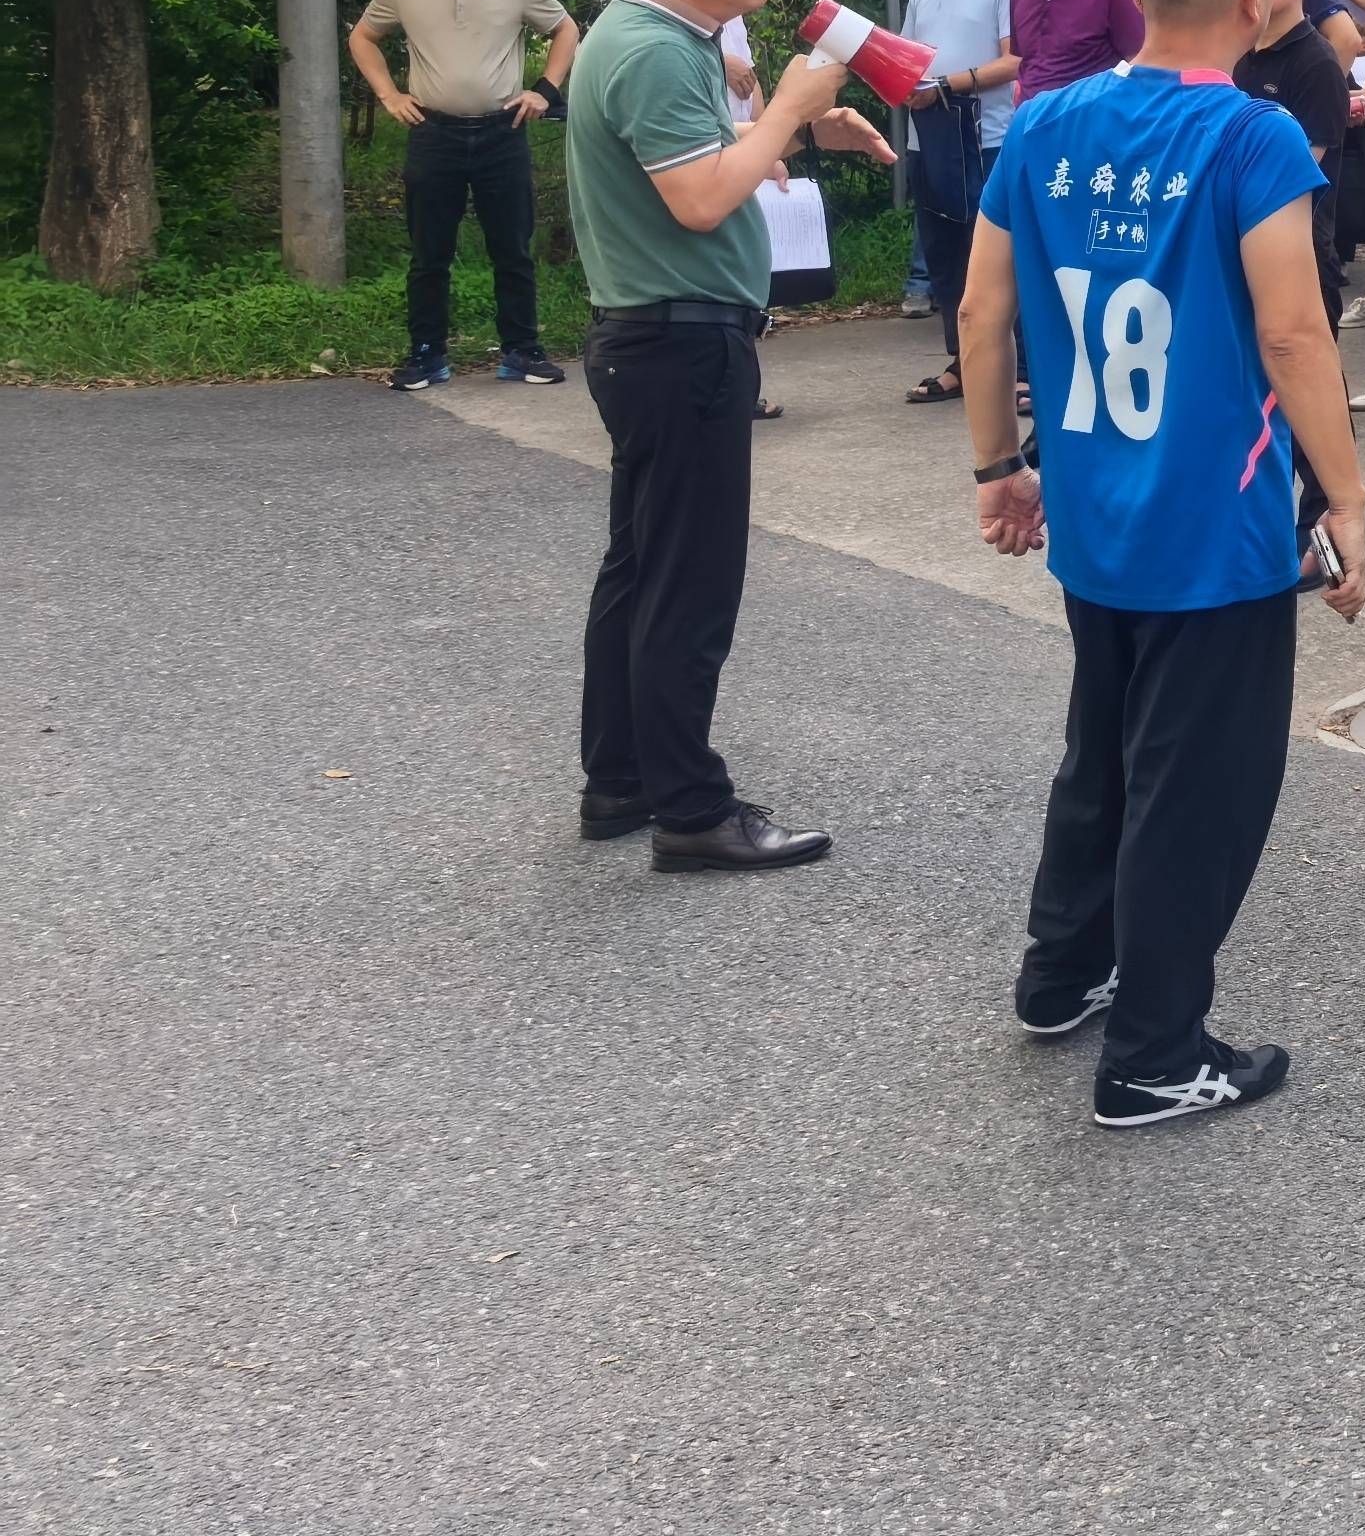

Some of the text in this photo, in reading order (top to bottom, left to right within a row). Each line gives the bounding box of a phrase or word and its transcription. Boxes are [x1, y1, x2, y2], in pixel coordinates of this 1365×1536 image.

[1045, 156, 1189, 205] 嘉舜农业
[1096, 220, 1145, 245] 手中粮
[1053, 266, 1173, 441] 18
